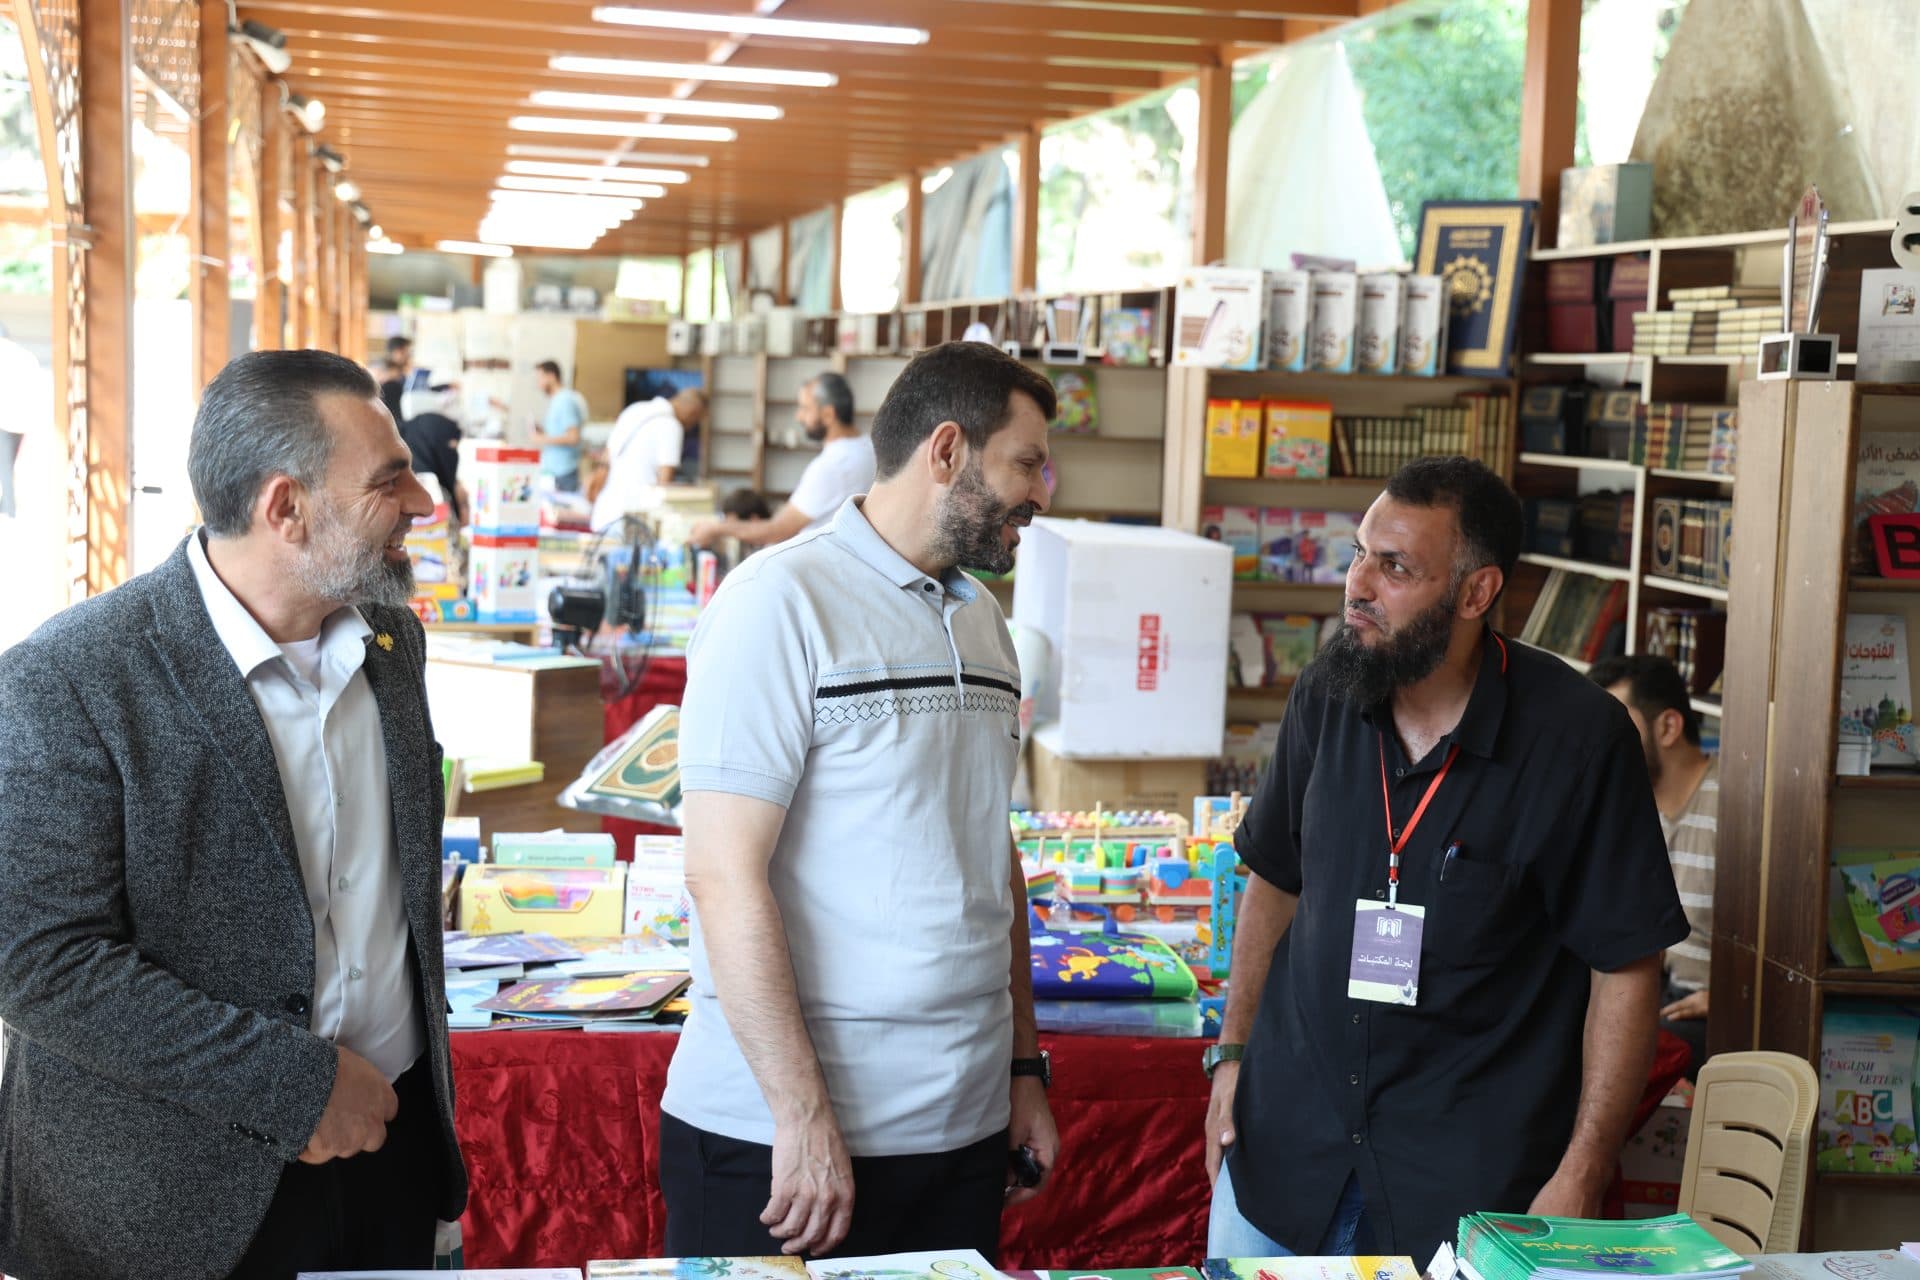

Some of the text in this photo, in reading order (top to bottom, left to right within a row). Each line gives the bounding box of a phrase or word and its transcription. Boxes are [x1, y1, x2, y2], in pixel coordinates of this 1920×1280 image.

[1849, 641, 1895, 664] الفتوحات
[1357, 953, 1413, 971] لجنة المكتبات
[1829, 1058, 1876, 1073] ENGLISH
[1858, 1073, 1905, 1086] LETTERS
[1835, 1091, 1893, 1126] ABC
